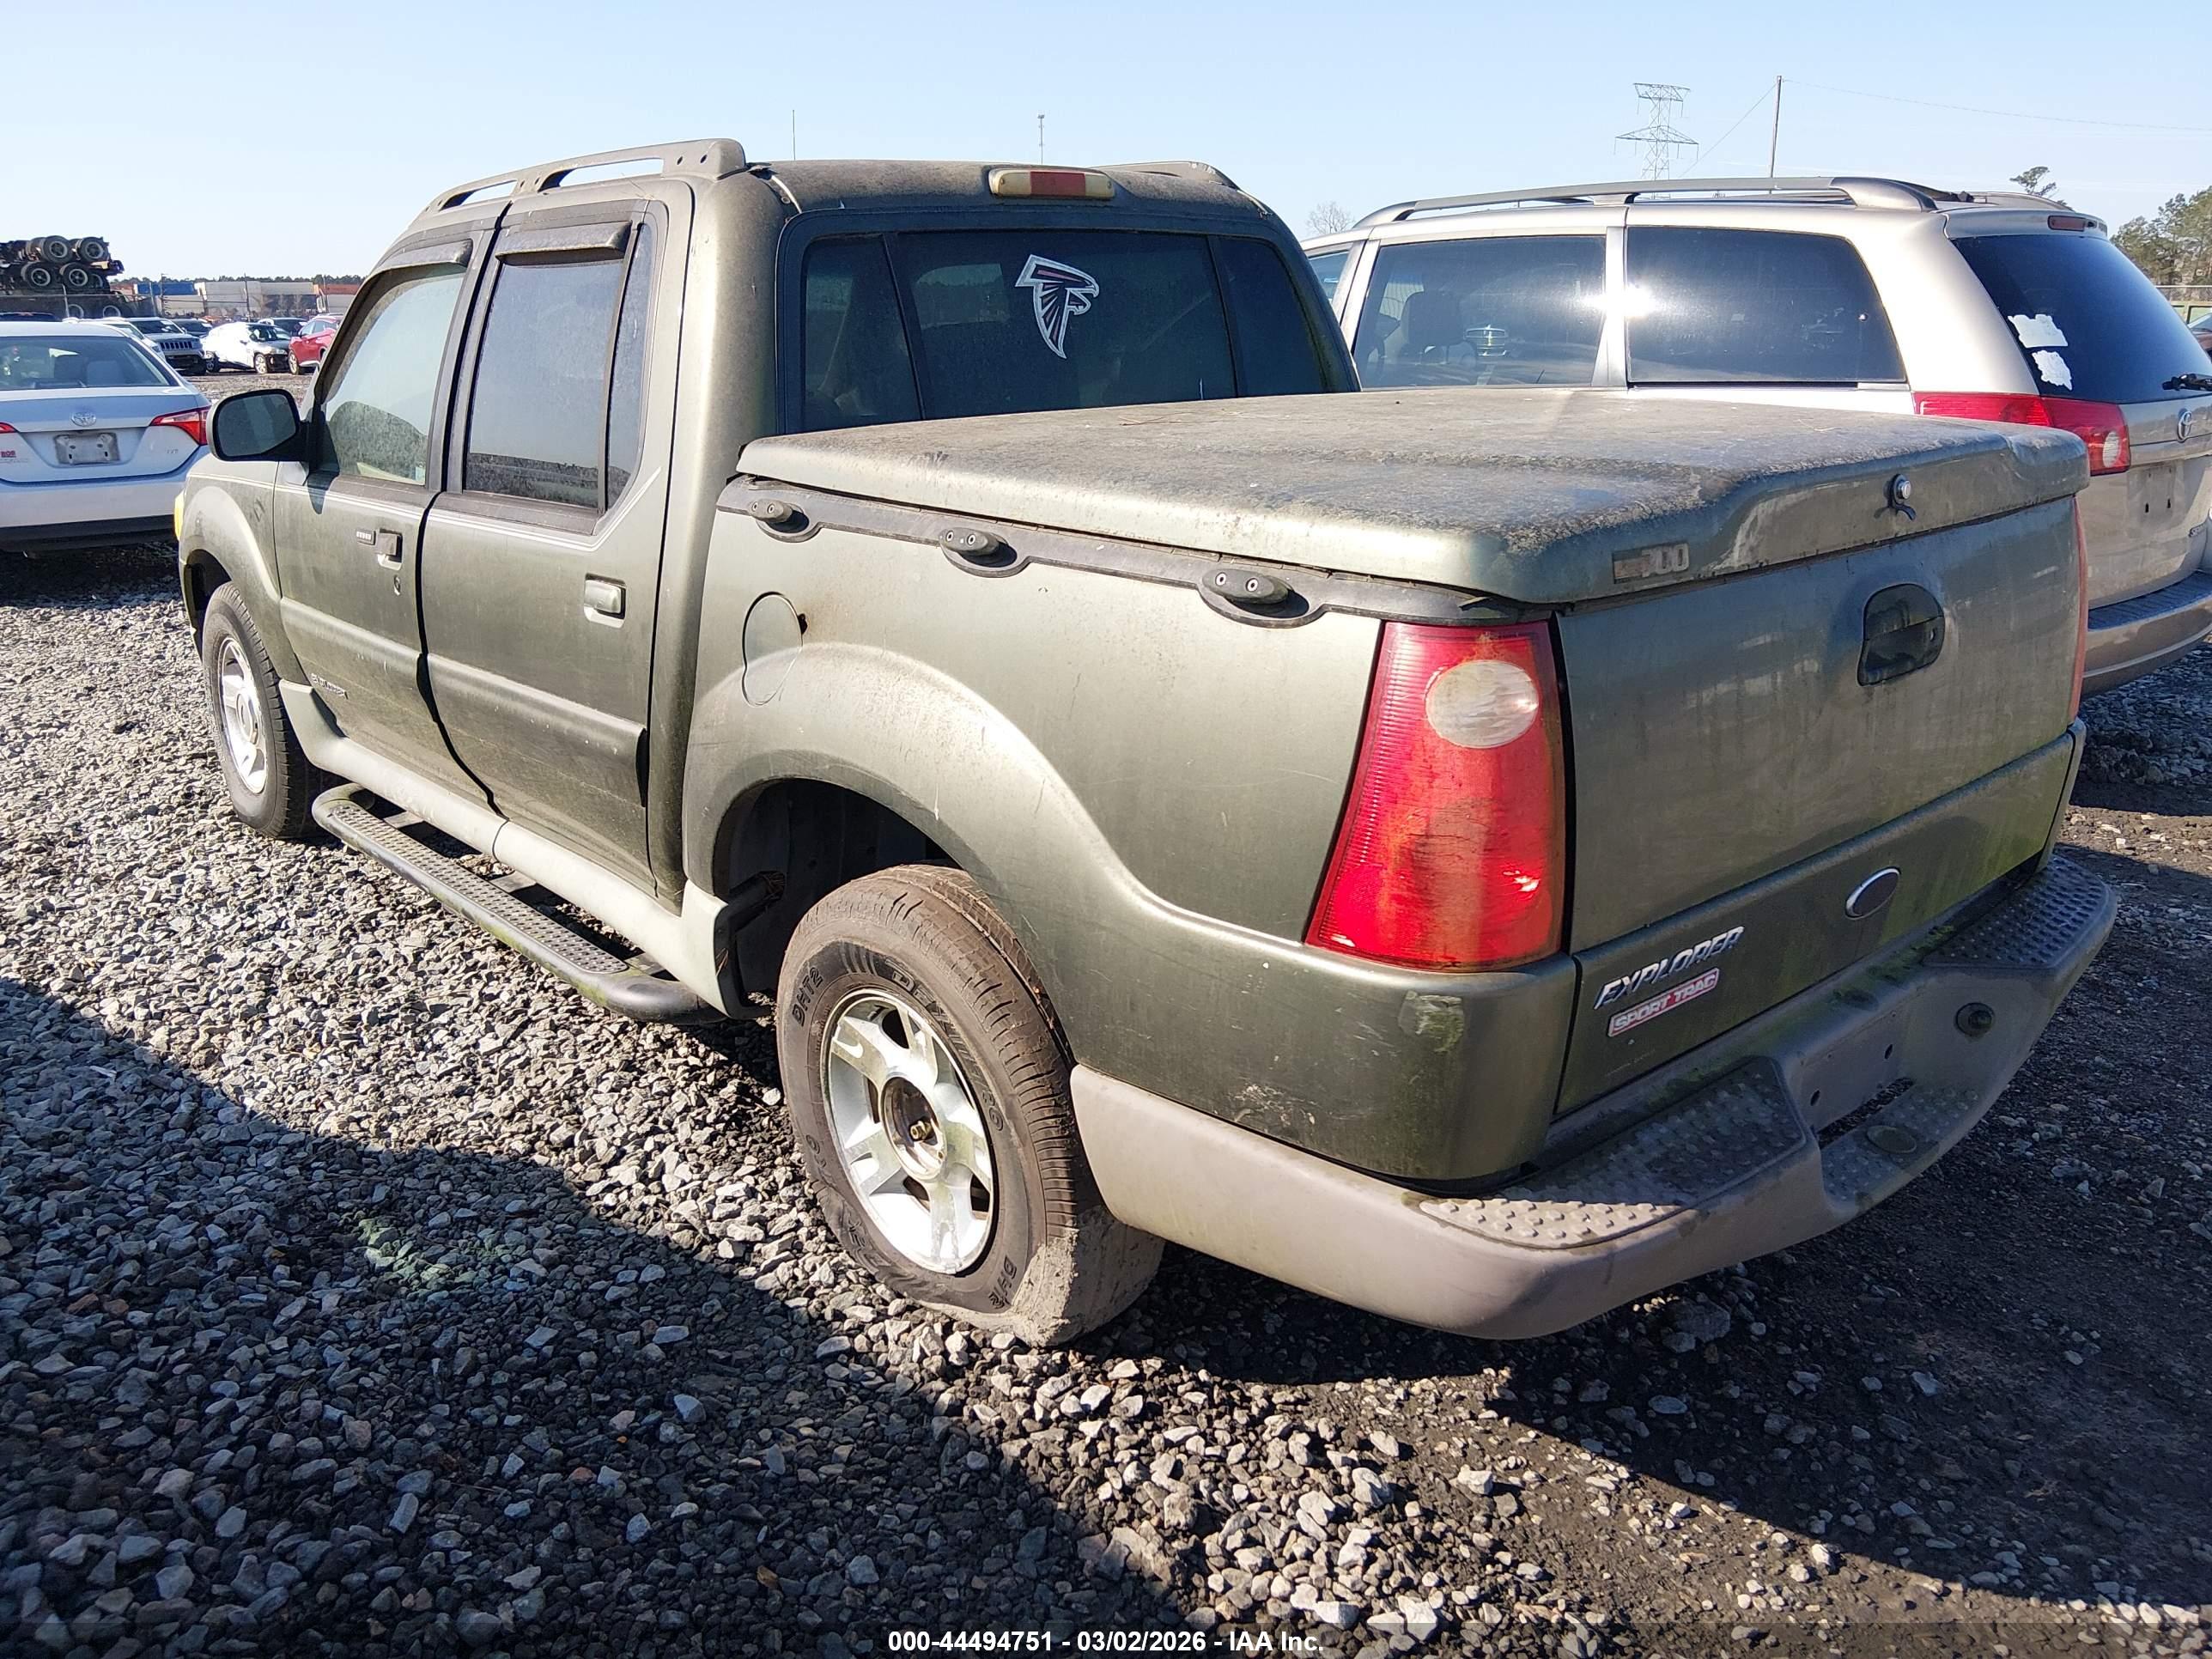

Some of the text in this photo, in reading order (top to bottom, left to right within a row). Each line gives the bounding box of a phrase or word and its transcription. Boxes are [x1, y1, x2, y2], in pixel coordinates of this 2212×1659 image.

[1595, 926, 1744, 1009] EXPLORER
[1614, 973, 1716, 1030] SPORT TRAC
